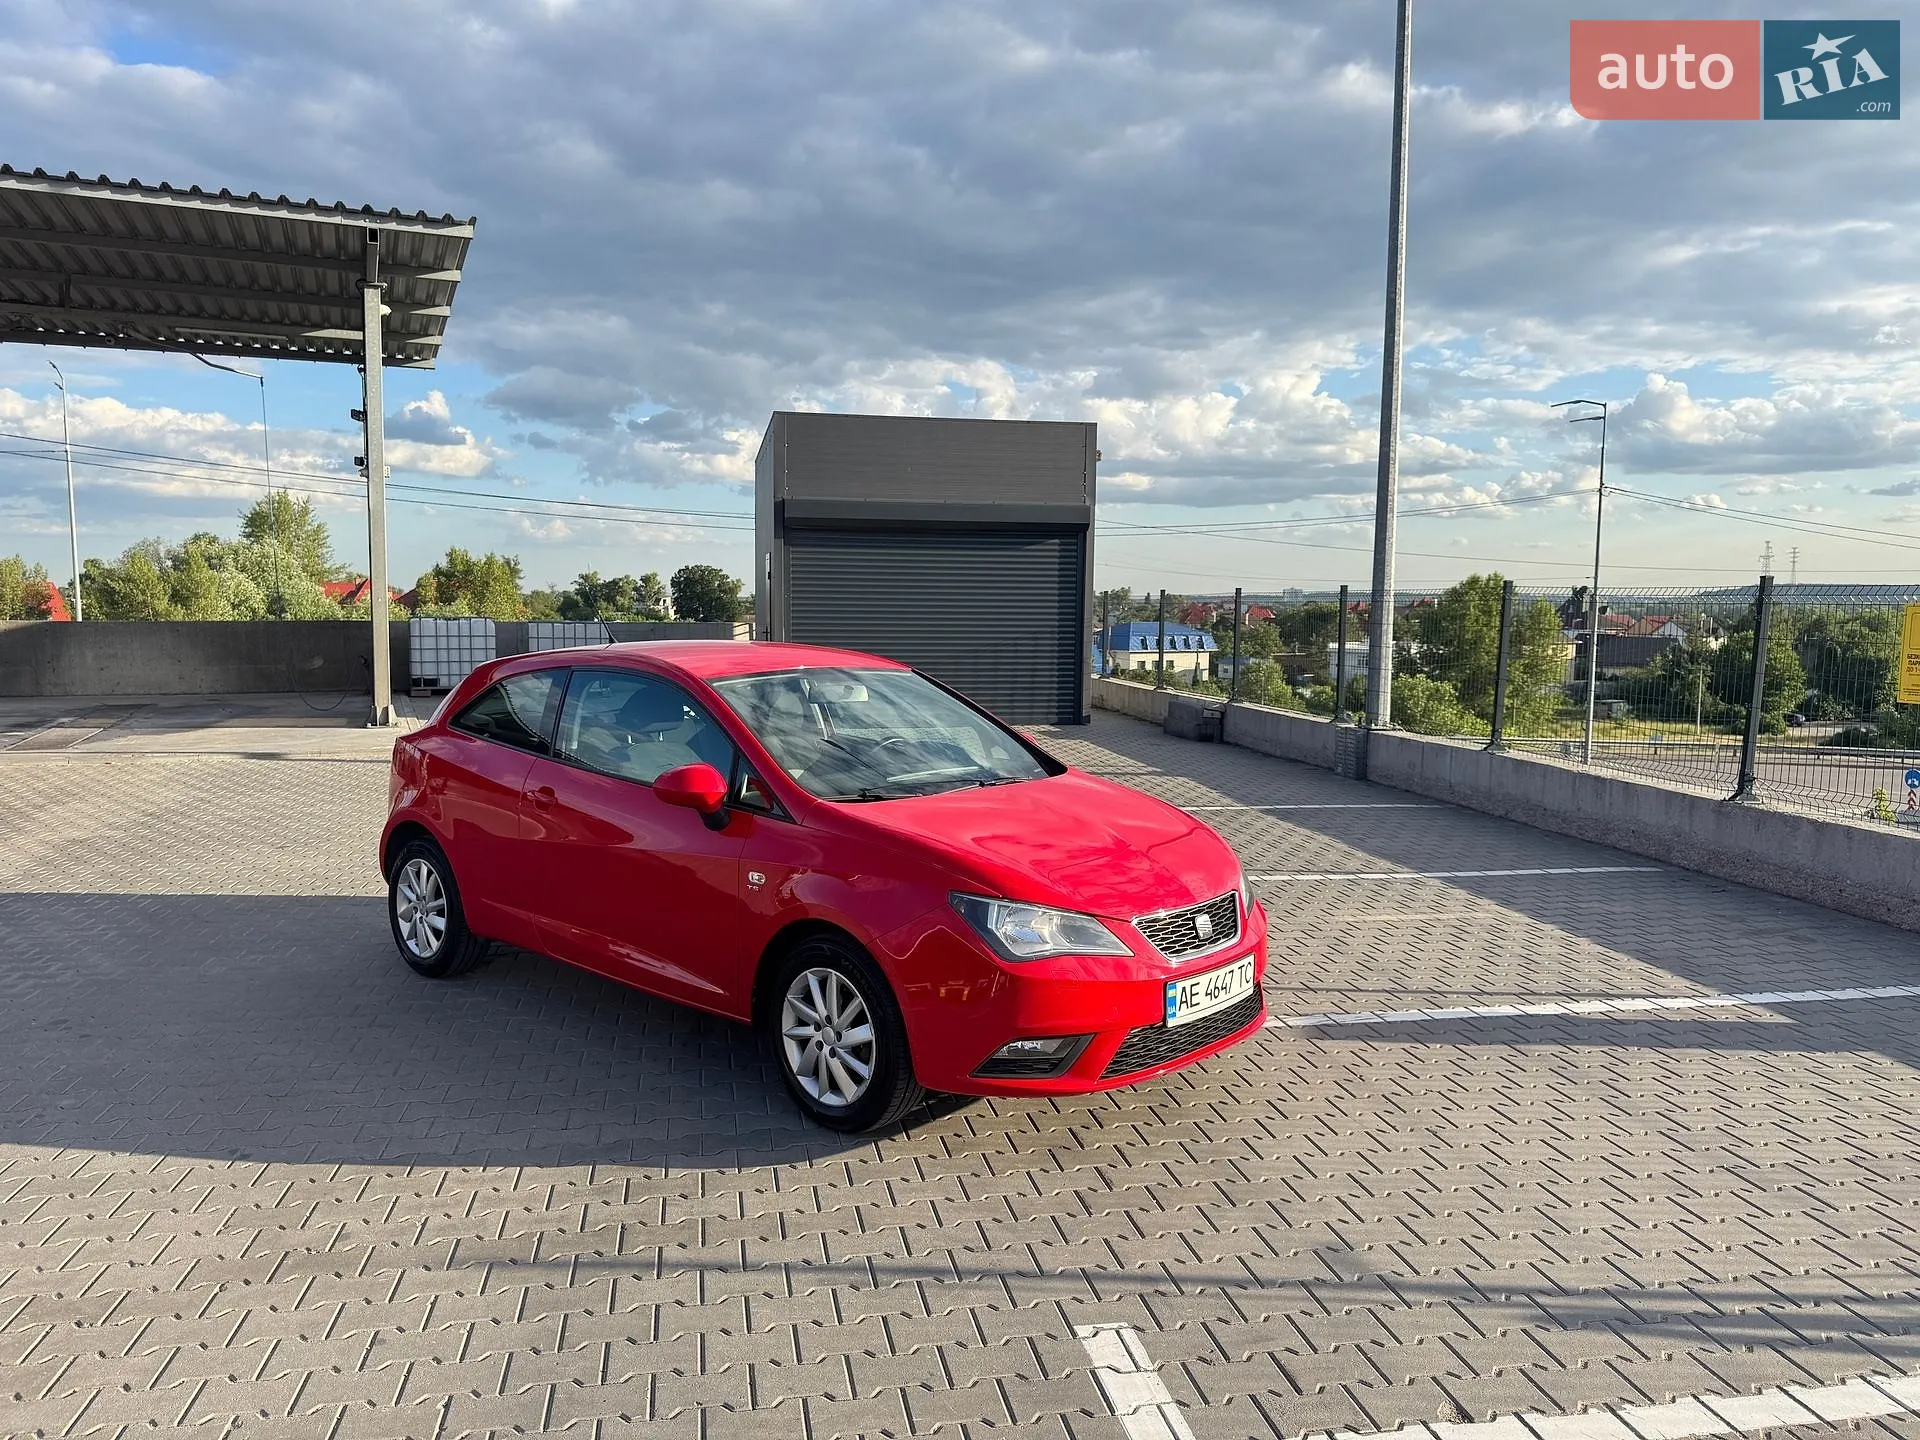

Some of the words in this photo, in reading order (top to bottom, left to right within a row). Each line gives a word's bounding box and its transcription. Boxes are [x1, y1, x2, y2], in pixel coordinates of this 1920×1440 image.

[1178, 981, 1200, 1012] AE
[1204, 969, 1234, 1002] 4647
[1238, 962, 1252, 988] TC
